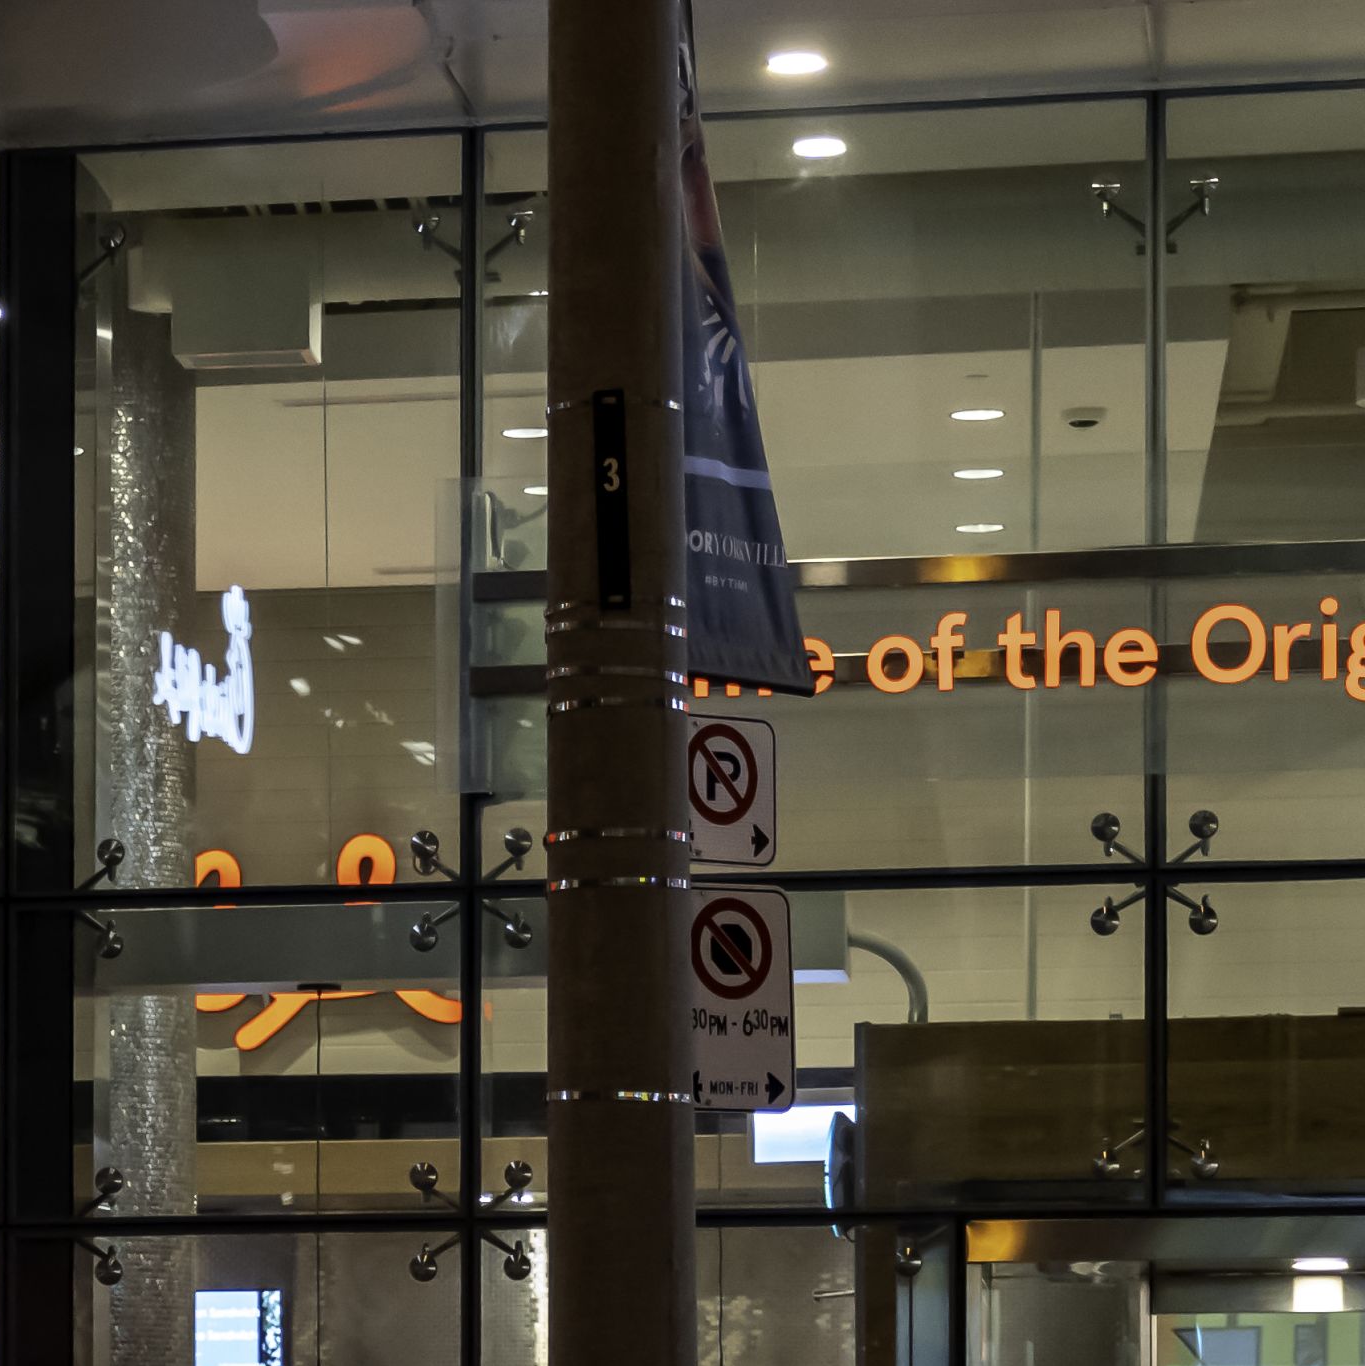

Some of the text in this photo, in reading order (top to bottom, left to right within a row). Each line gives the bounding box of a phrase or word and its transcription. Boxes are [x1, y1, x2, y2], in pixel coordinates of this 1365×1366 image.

[602, 457, 620, 493] 3
[866, 611, 968, 693] of
[998, 608, 1159, 690] the
[709, 1080, 759, 1097] MON-FRI
